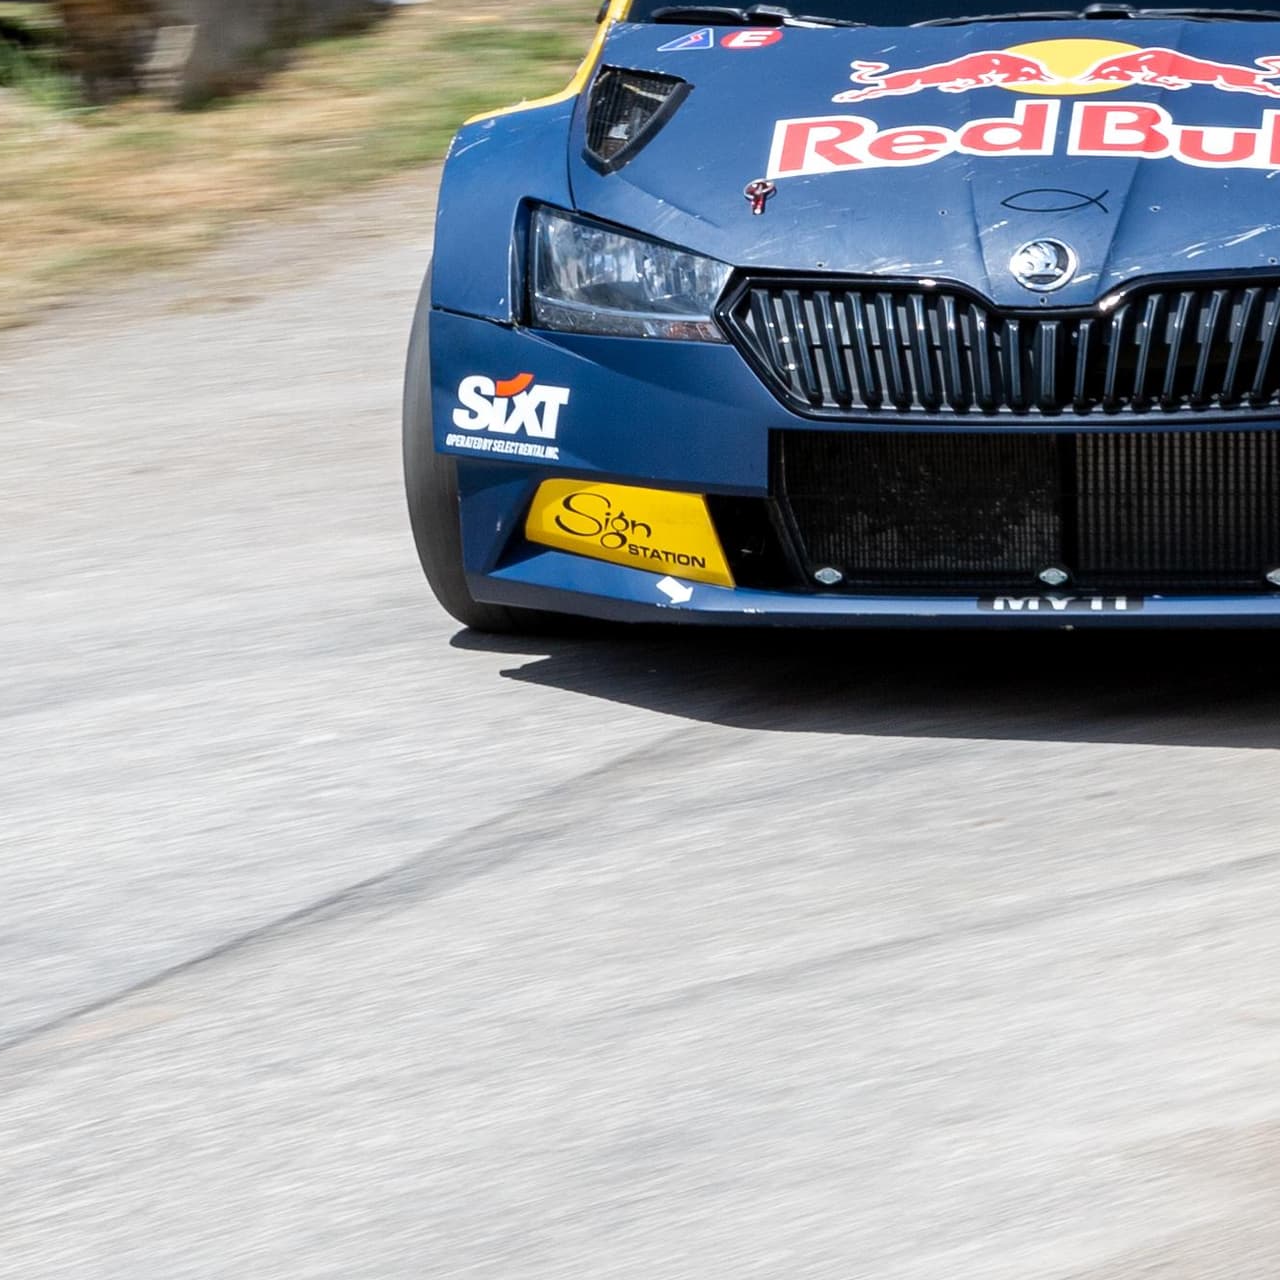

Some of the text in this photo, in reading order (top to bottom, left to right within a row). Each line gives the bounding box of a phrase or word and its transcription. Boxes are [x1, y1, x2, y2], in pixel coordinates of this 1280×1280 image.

[777, 103, 1050, 174] Red
[446, 433, 483, 451] OPERATED
[493, 439, 519, 454] SELECT
[555, 492, 652, 549] Sign
[628, 543, 706, 568] STATION
